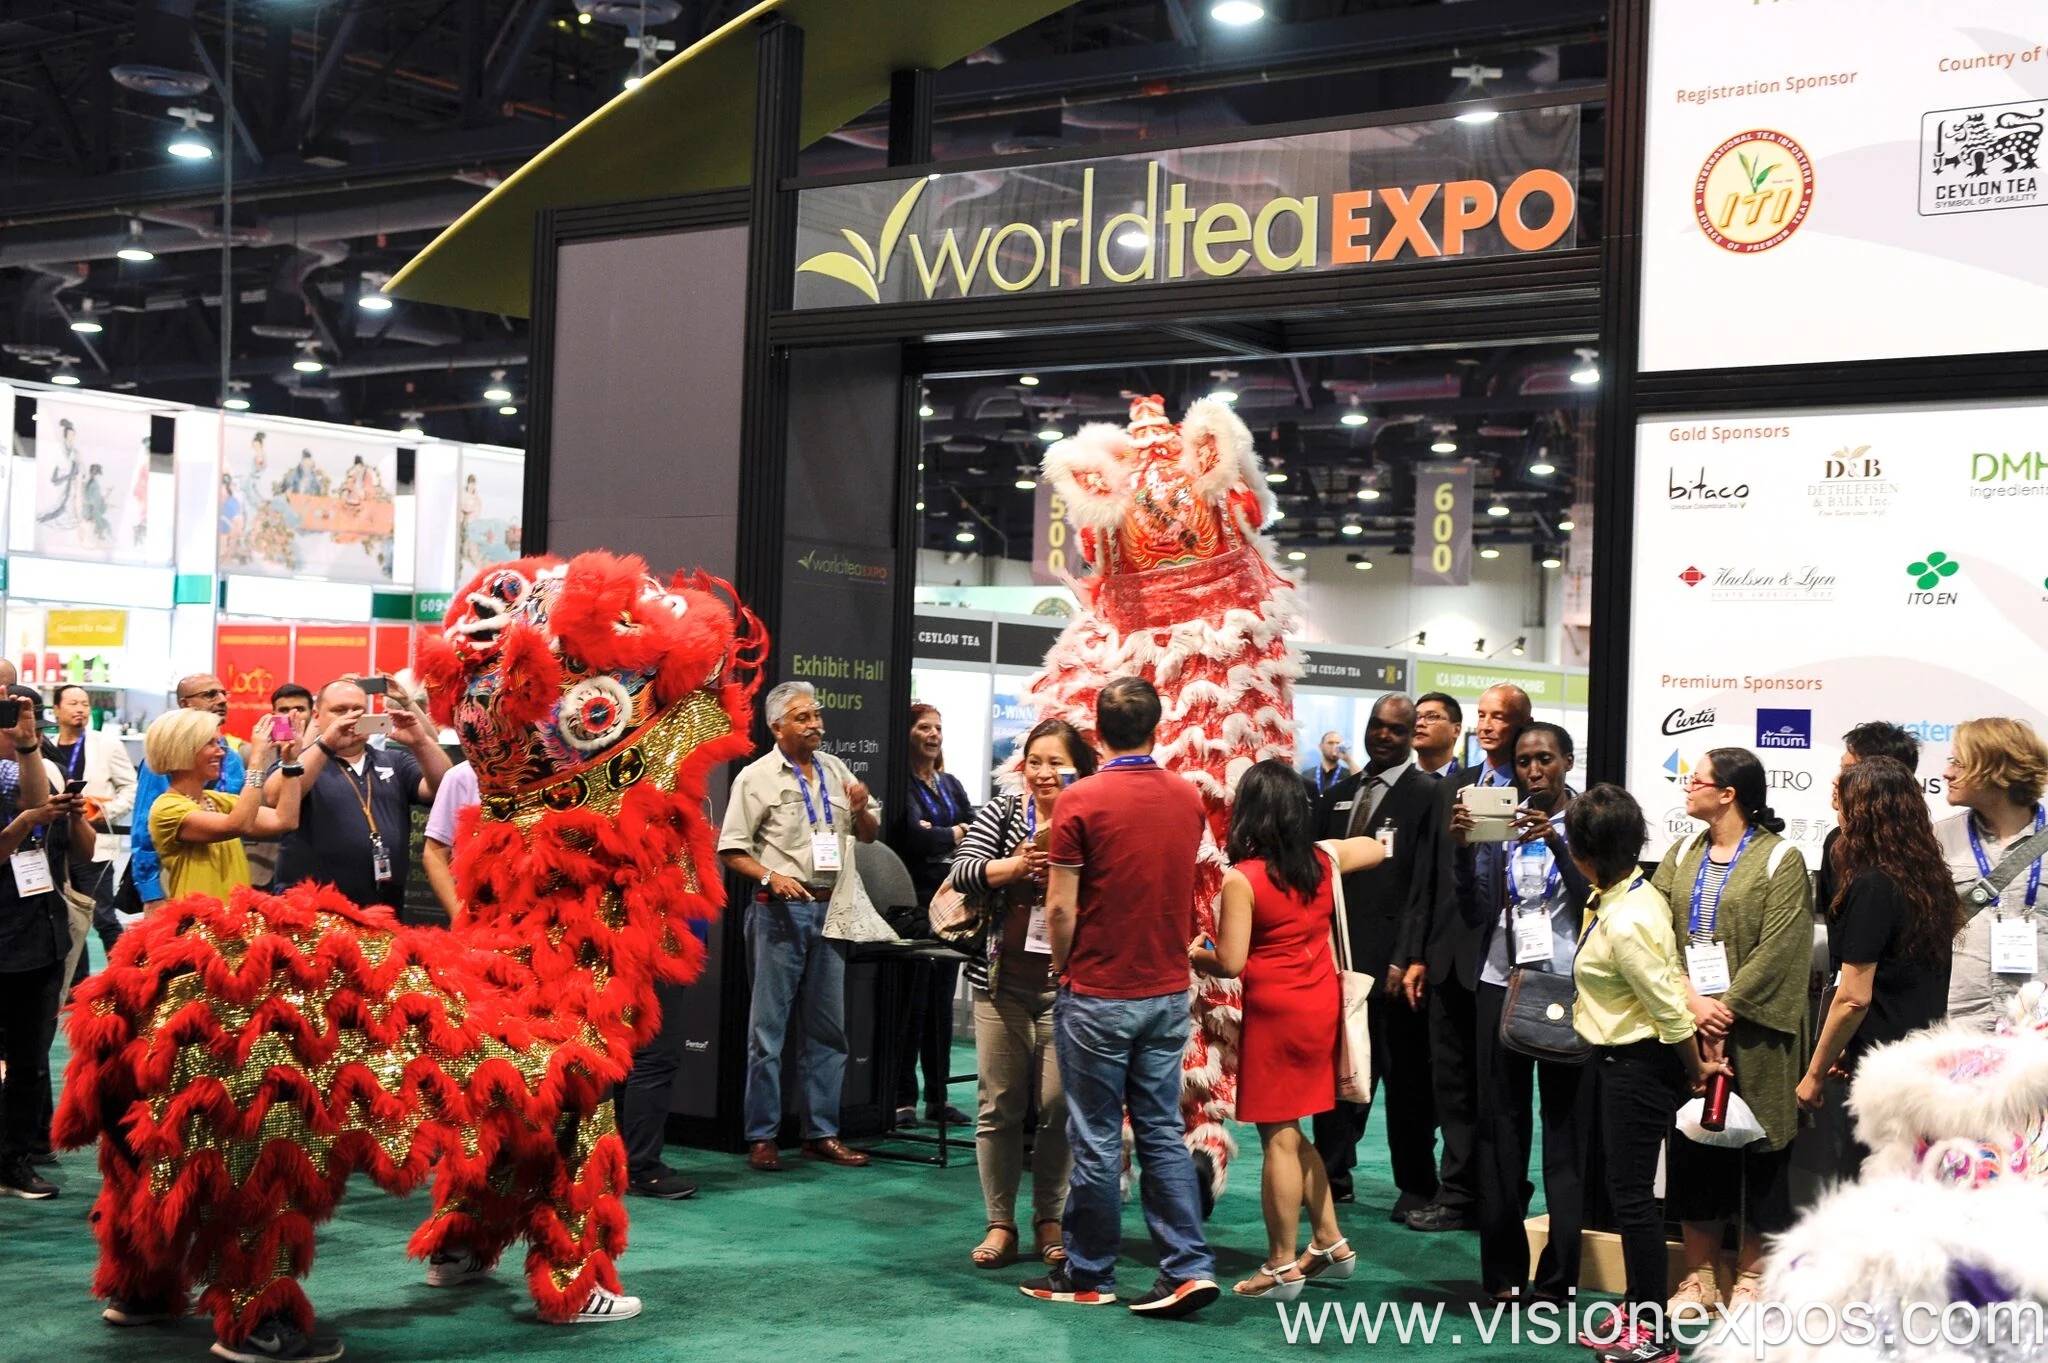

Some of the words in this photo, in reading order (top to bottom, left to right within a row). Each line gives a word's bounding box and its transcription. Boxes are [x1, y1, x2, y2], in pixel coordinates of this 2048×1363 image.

[1938, 52, 2016, 73] Country
[2021, 46, 2041, 63] of
[1676, 80, 1780, 105] Registration
[1785, 71, 1858, 94] Sponsor
[1755, 131, 1776, 141] TEA
[1936, 180, 2001, 200] CEYLON
[2007, 177, 2037, 193] TEA
[1719, 187, 1792, 229] ITI
[1935, 199, 1976, 209] SYMBOL
[1978, 197, 1992, 206] OF
[1994, 193, 2038, 203] QUALITY
[1669, 426, 1706, 442] Gold
[1711, 425, 1790, 443] Sponsors
[1669, 466, 1750, 500] bitaco
[1432, 482, 1455, 573] 600
[918, 631, 959, 647] CEYLON
[961, 634, 980, 647] TEA
[793, 654, 849, 679] Exhibit
[854, 659, 884, 681] Hall
[1661, 674, 1738, 689] Premium
[1743, 675, 1823, 693] Sponsors
[815, 688, 863, 711] Hours
[1662, 708, 1716, 736] Curtis
[835, 740, 856, 754] June
[1766, 769, 1813, 791] TRO
[1667, 820, 1695, 834] tea
